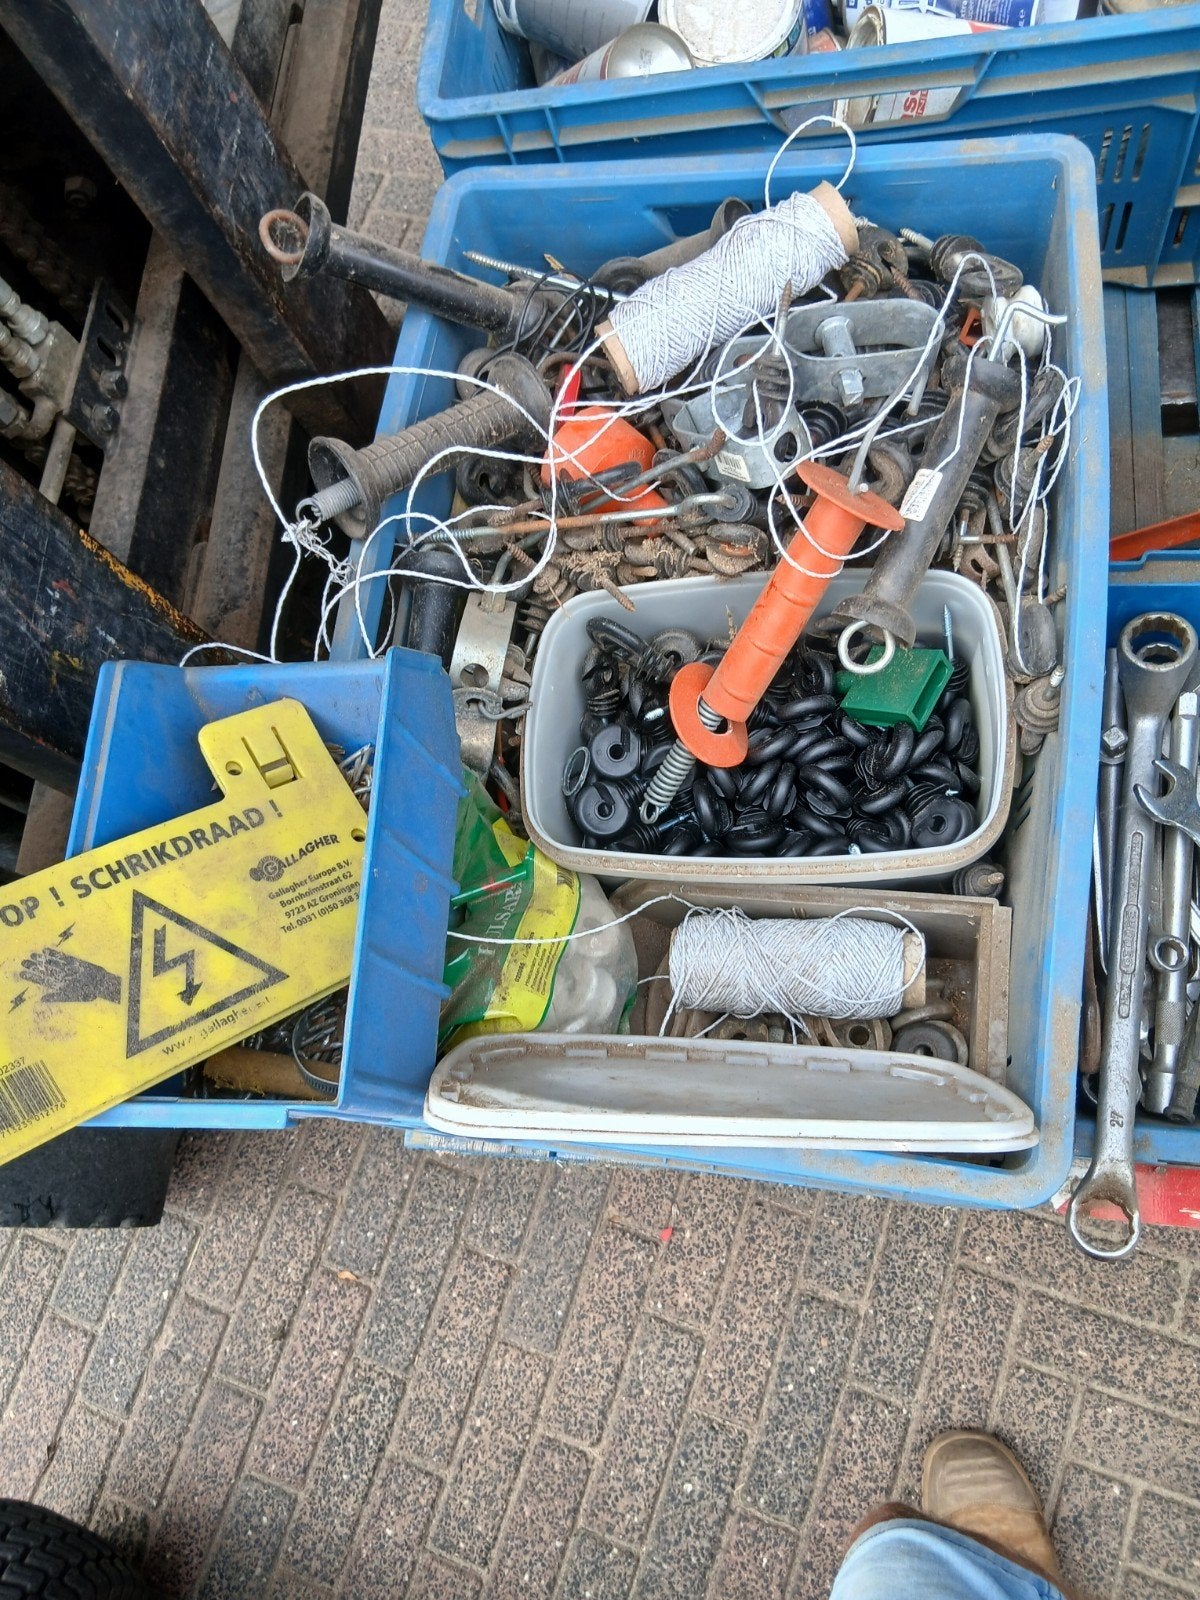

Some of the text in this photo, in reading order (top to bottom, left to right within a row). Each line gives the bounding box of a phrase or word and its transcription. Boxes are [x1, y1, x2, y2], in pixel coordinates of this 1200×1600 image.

[49, 886, 65, 907] !
[70, 807, 265, 899] SCHRIKDRAAD
[269, 800, 283, 818] !
[262, 834, 340, 876] GALLAGHER
[268, 859, 352, 900] Gallagher Europe B.V.
[280, 871, 353, 908] Bornholmstraat 62
[281, 922, 297, 933] Tel.
[297, 913, 318, 926] 0031
[318, 904, 339, 917] (0)50
[338, 896, 354, 907] 368
[285, 881, 360, 919] 9723 AZ Groningen
[1110, 1110, 1124, 1128] 27
